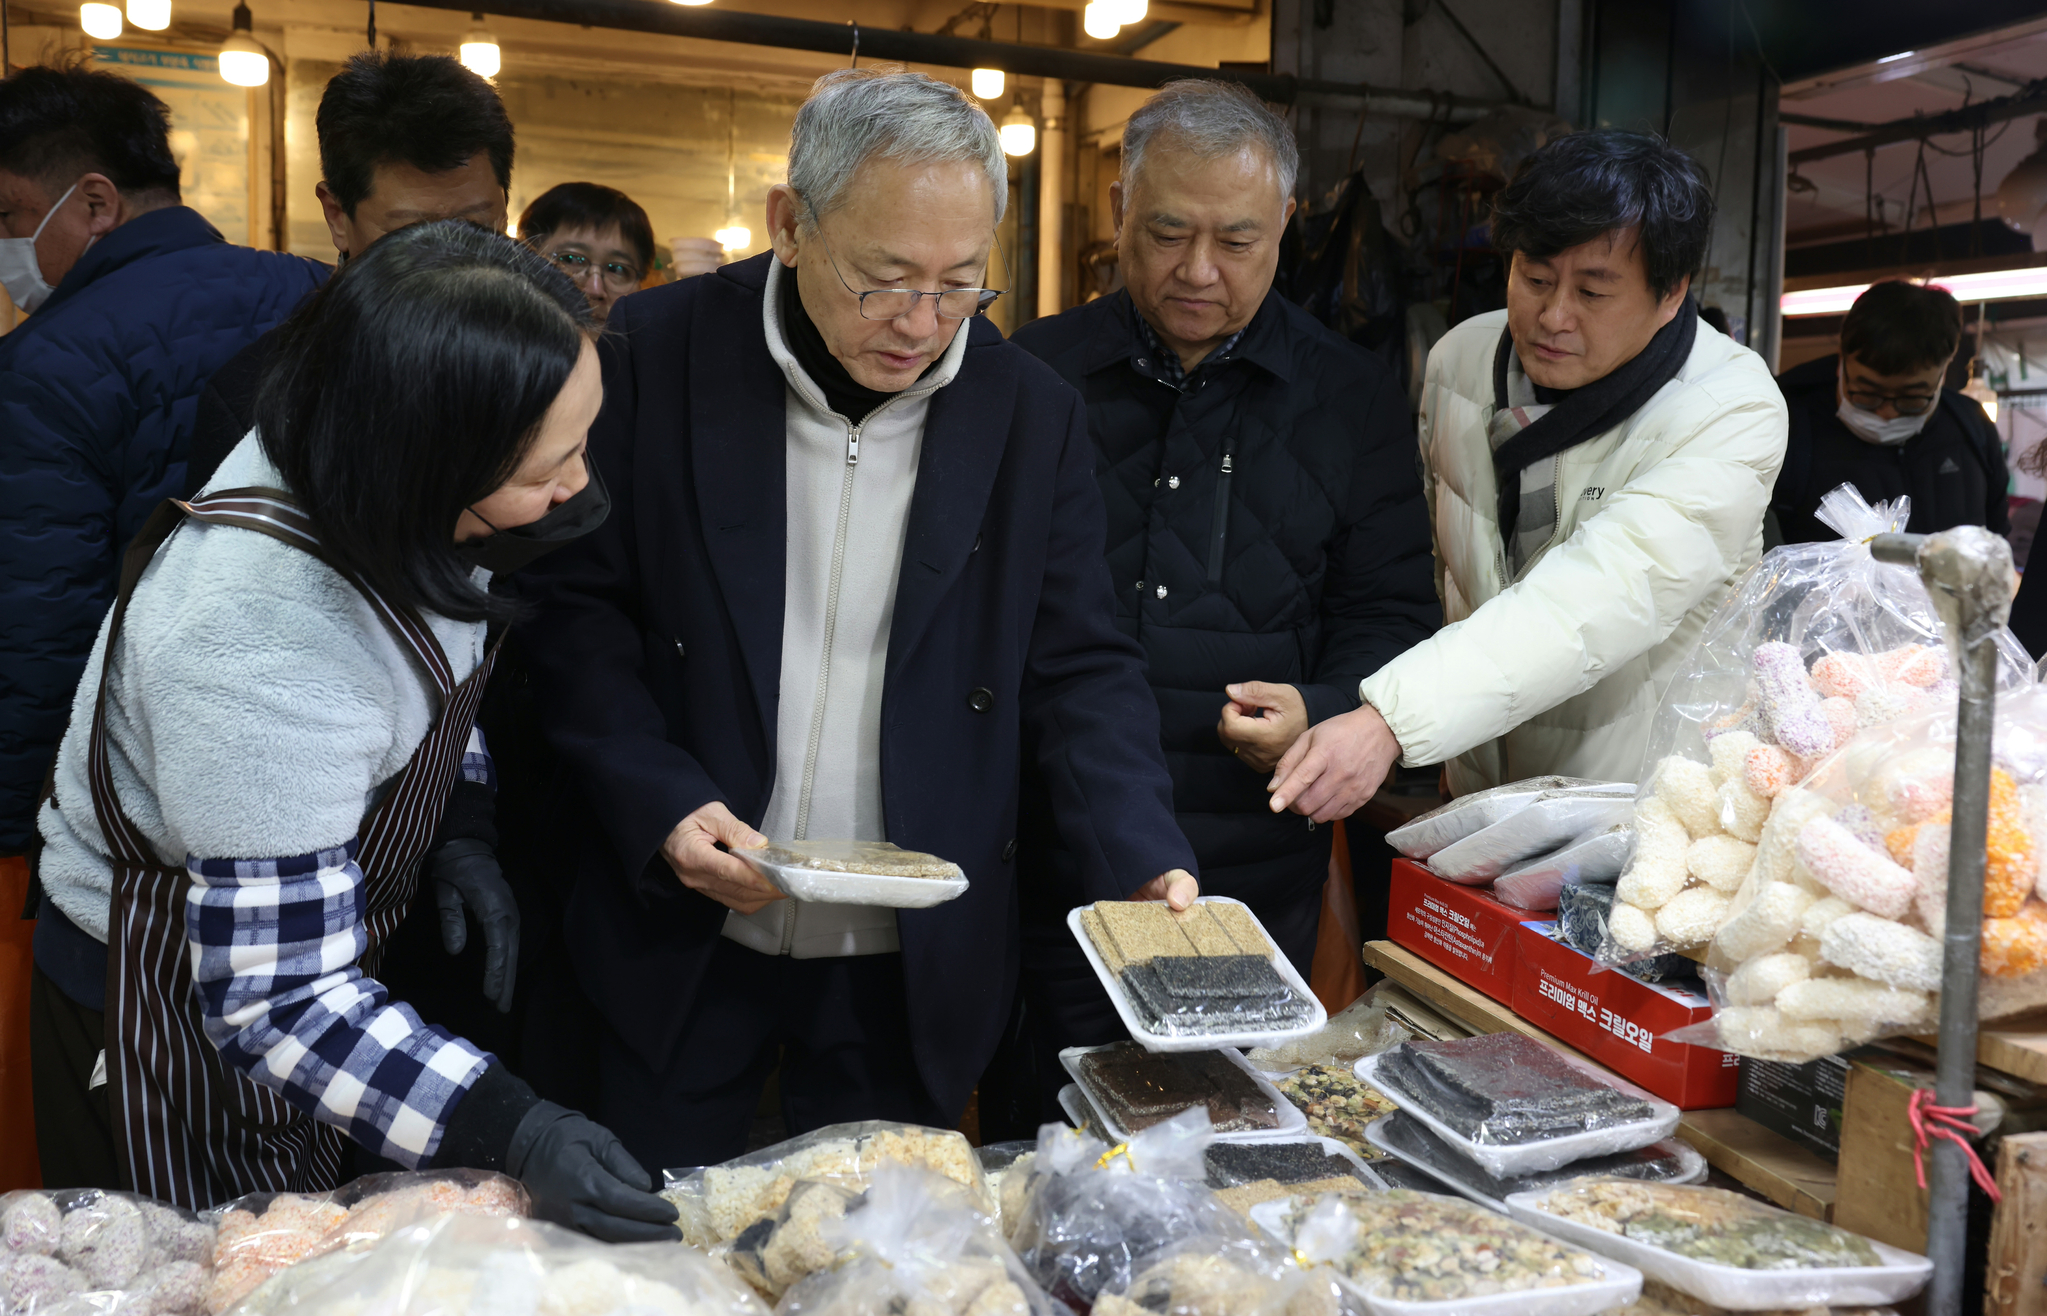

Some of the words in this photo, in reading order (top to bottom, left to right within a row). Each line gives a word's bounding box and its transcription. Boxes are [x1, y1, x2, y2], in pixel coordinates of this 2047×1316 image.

[1423, 898, 1439, 913] 프리미엄
[1439, 906, 1448, 917] 맥스
[1540, 968, 1565, 988] Premium
[1565, 981, 1577, 994] Max
[1577, 988, 1589, 1001] Krill
[1589, 995, 1598, 1006] Oil
[1538, 979, 1576, 1012] 프리미엄
[1577, 999, 1597, 1023] 맥스
[1598, 1007, 1653, 1054] 크릴오일
